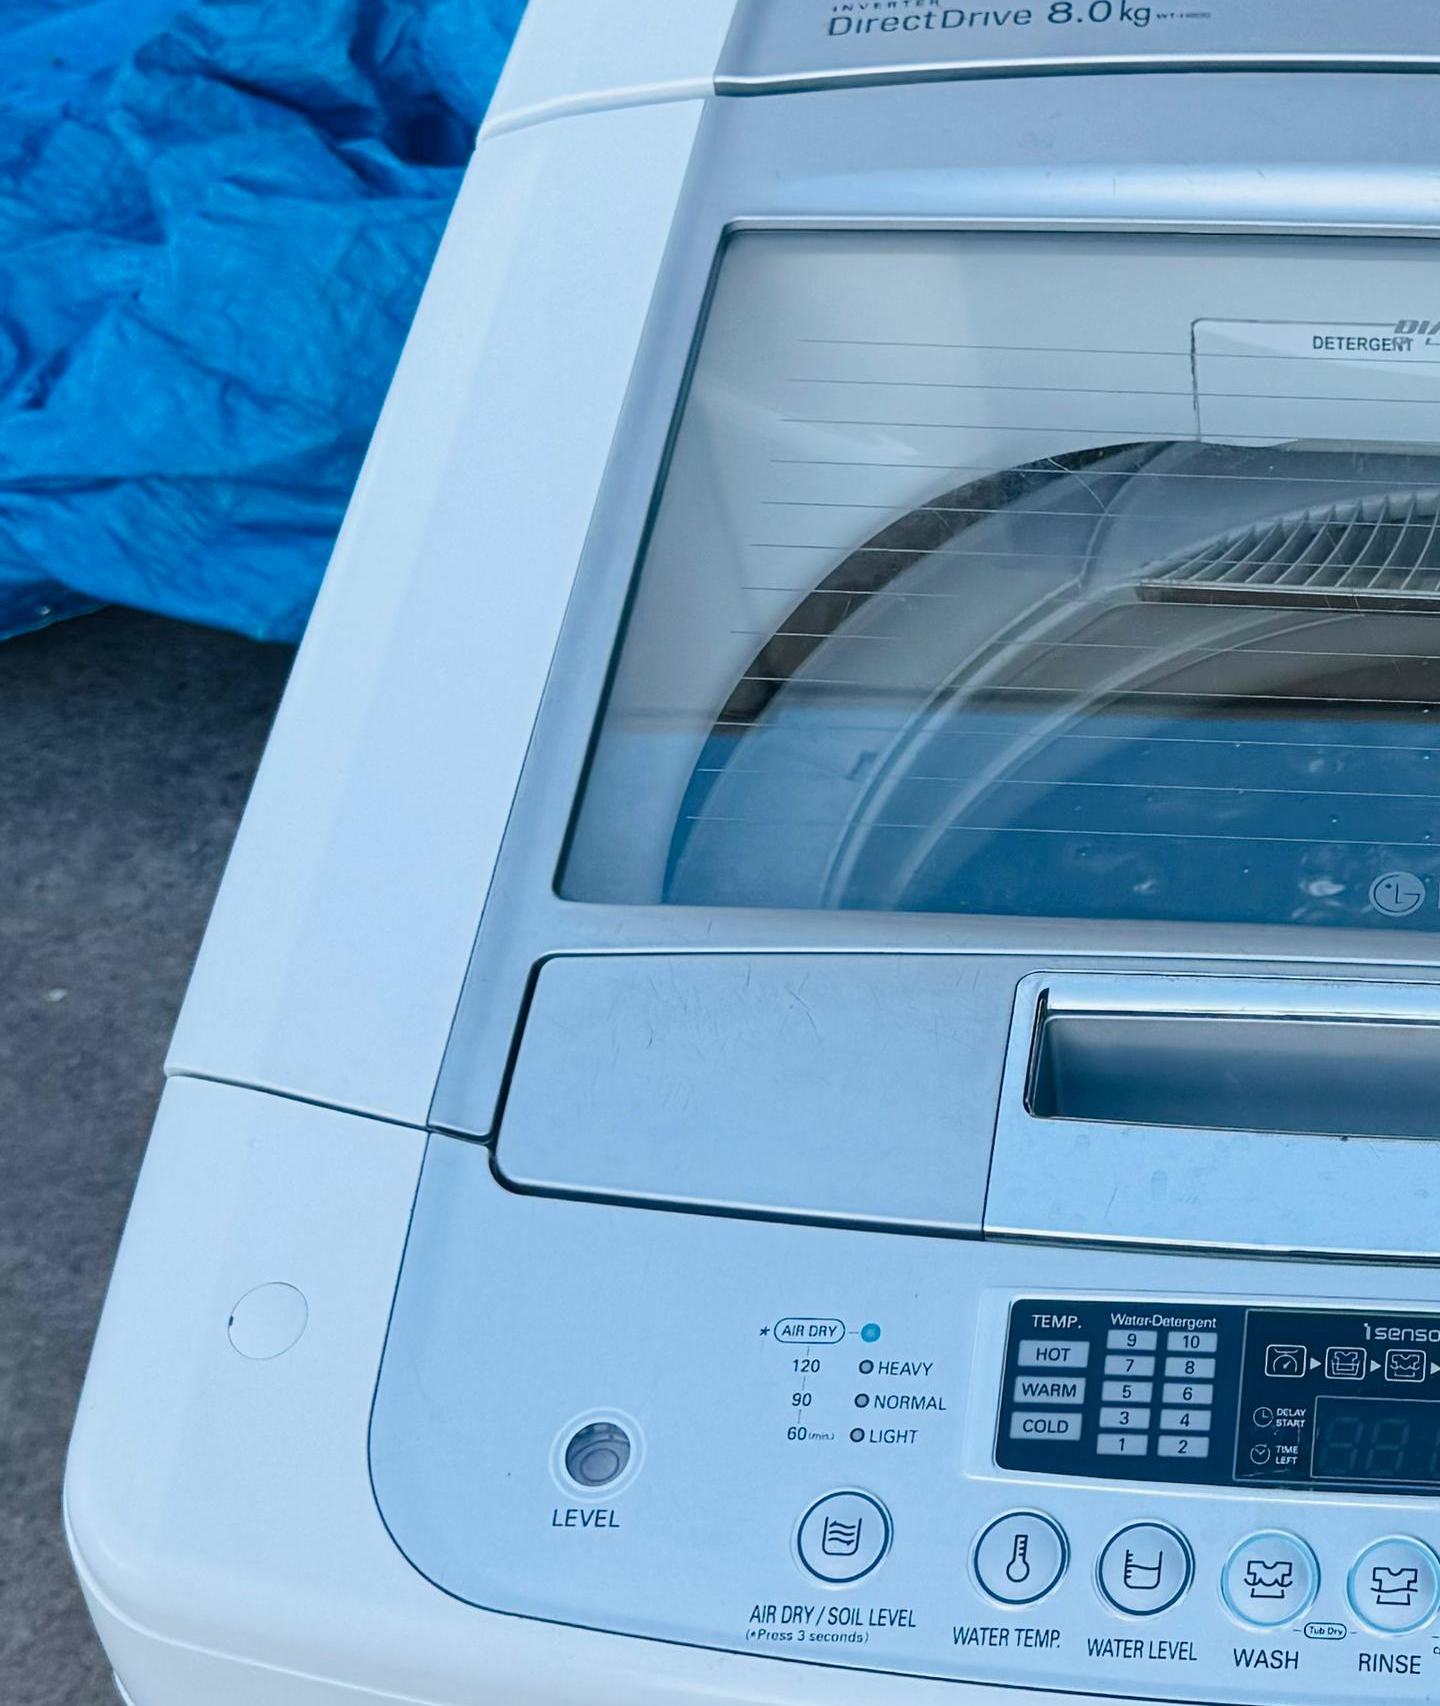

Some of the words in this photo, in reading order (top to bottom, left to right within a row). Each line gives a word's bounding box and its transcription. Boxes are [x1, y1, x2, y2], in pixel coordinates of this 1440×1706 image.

[1312, 335, 1414, 353] DETERGENT
[1031, 1313, 1082, 1330] TEMP.
[781, 1325, 805, 1337] AIR
[808, 1325, 838, 1337] DRY
[1126, 1334, 1137, 1348] 9
[1183, 1335, 1200, 1350] 10
[1035, 1347, 1071, 1363] HOT
[792, 1359, 821, 1373] 120
[878, 1361, 934, 1376] HEAVY
[1125, 1359, 1135, 1373] 7
[1185, 1360, 1195, 1375] 8
[1021, 1382, 1078, 1398] WARM
[1122, 1384, 1132, 1398] 5
[1182, 1386, 1193, 1401] 6
[791, 1392, 812, 1407] 90
[873, 1395, 947, 1410] NORMAL
[1119, 1411, 1130, 1425] 3
[1179, 1412, 1190, 1427] 4
[1275, 1407, 1307, 1418] DELAY
[1022, 1418, 1069, 1434] COLD
[1275, 1417, 1306, 1428] START
[869, 1429, 918, 1444] LIGHT
[1118, 1438, 1125, 1452] 1
[1177, 1439, 1188, 1454] 2
[1275, 1445, 1299, 1455] TIME
[1275, 1455, 1298, 1466] LEFT
[551, 1509, 621, 1528] LEVEL
[749, 1604, 776, 1624] AIR
[781, 1605, 815, 1626] DRY
[828, 1606, 864, 1626] SOIL
[869, 1608, 917, 1628] LEVEL
[798, 1629, 805, 1641] 3
[953, 1626, 1009, 1648] WATER
[1309, 1626, 1325, 1635] Tub
[1328, 1626, 1343, 1637] Dry
[1087, 1638, 1144, 1660] WATER
[1149, 1639, 1198, 1662] LEVEL
[1233, 1648, 1300, 1671] WASH
[1358, 1653, 1421, 1675] RINSE
